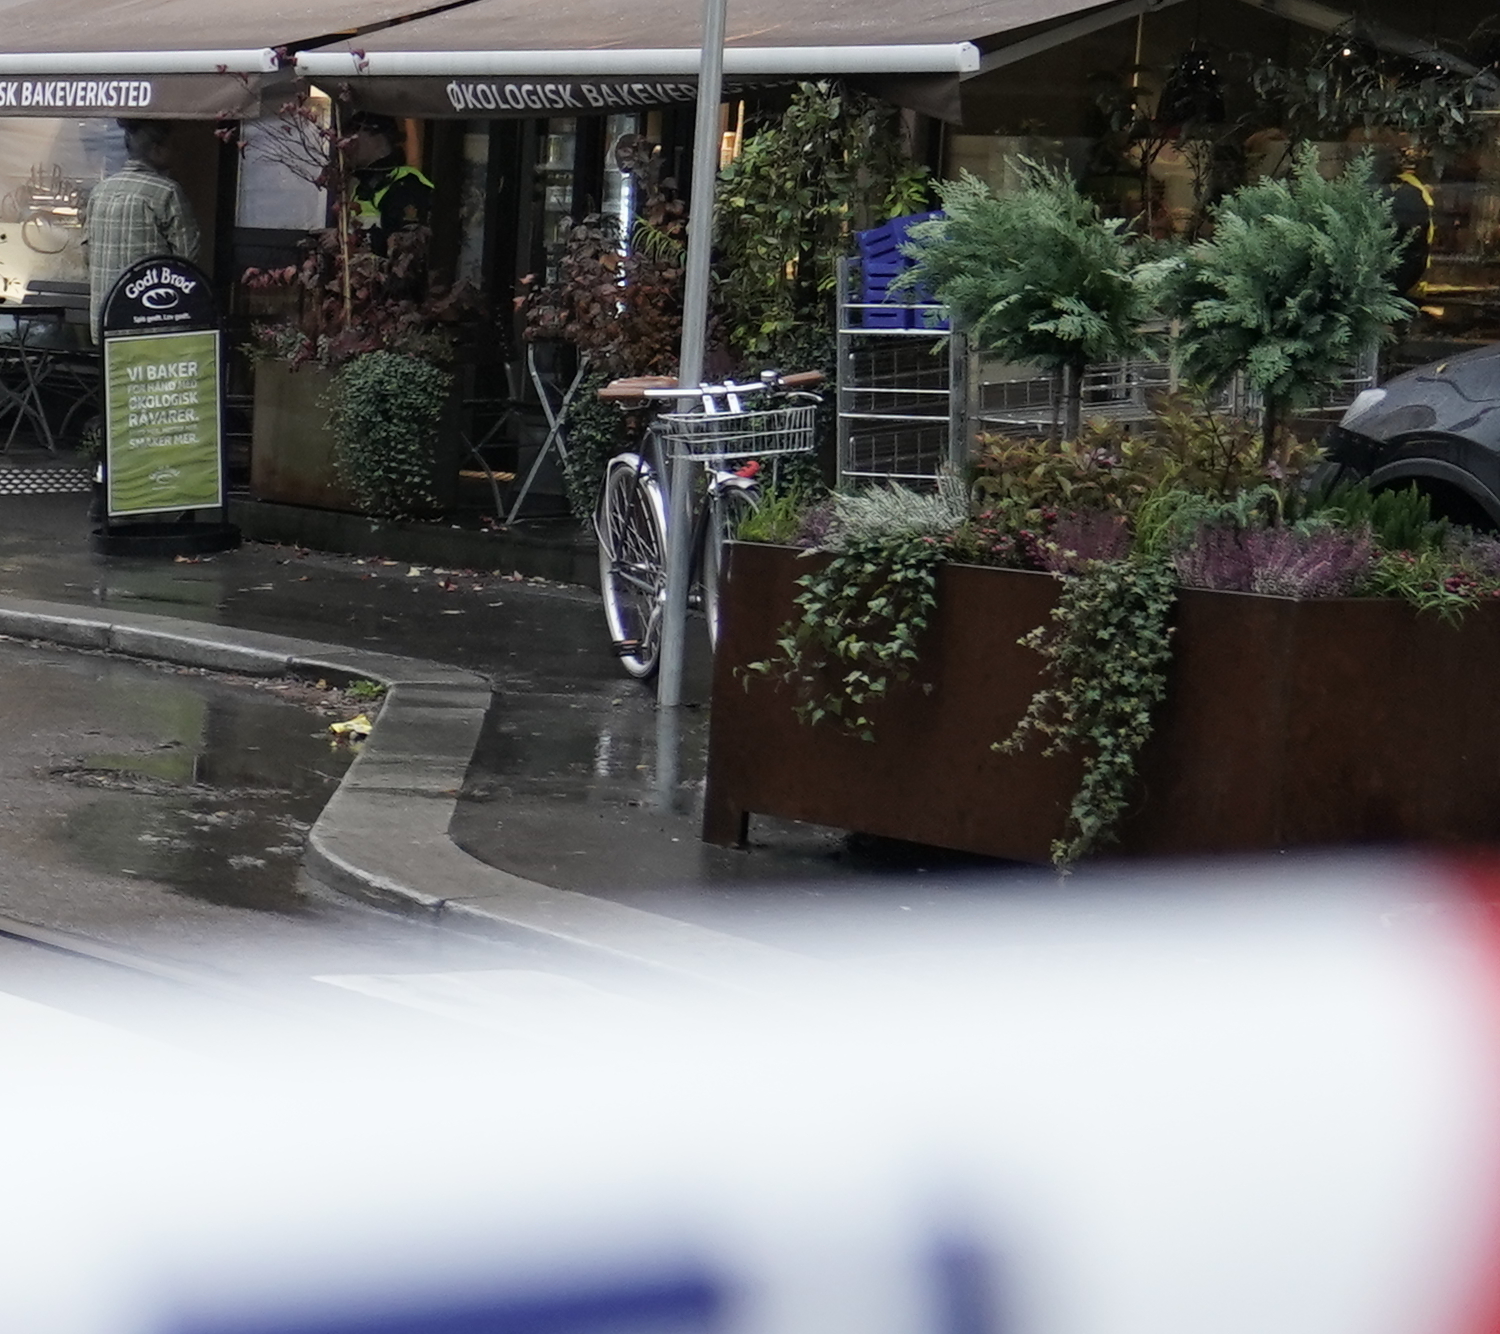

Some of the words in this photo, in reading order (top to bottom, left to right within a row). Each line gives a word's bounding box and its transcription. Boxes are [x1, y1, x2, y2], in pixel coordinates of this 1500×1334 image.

[21, 81, 152, 107] BAKEVERKSTED
[446, 80, 583, 112] ØKOLOGISK
[125, 268, 159, 298] Godt
[160, 267, 196, 294] Brød
[126, 366, 143, 381] VI
[146, 362, 198, 381] BAKER
